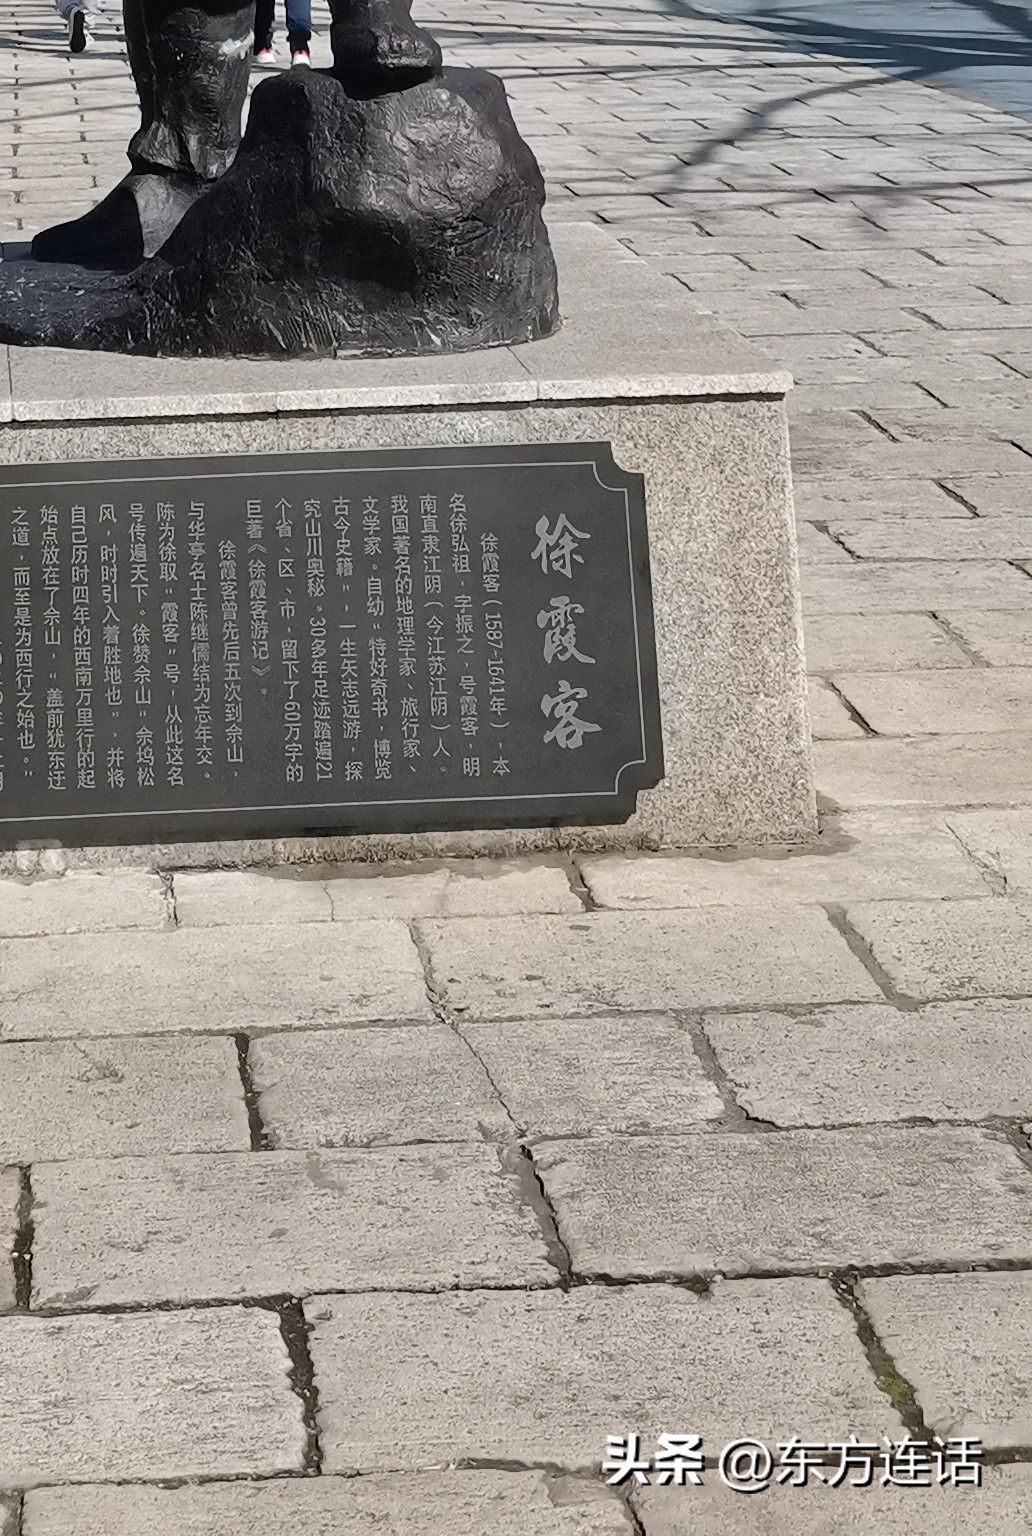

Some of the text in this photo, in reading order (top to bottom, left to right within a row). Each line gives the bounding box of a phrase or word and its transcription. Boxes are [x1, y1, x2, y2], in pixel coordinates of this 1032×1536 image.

[71, 505, 96, 788] 自己历时四年的西南万里行的起
[188, 500, 213, 780] 与华亭名士陈继儒结为忘年交。
[390, 495, 422, 774] 我国著名的地理学家、旅行家、
[530, 513, 603, 750] 徐霞客
